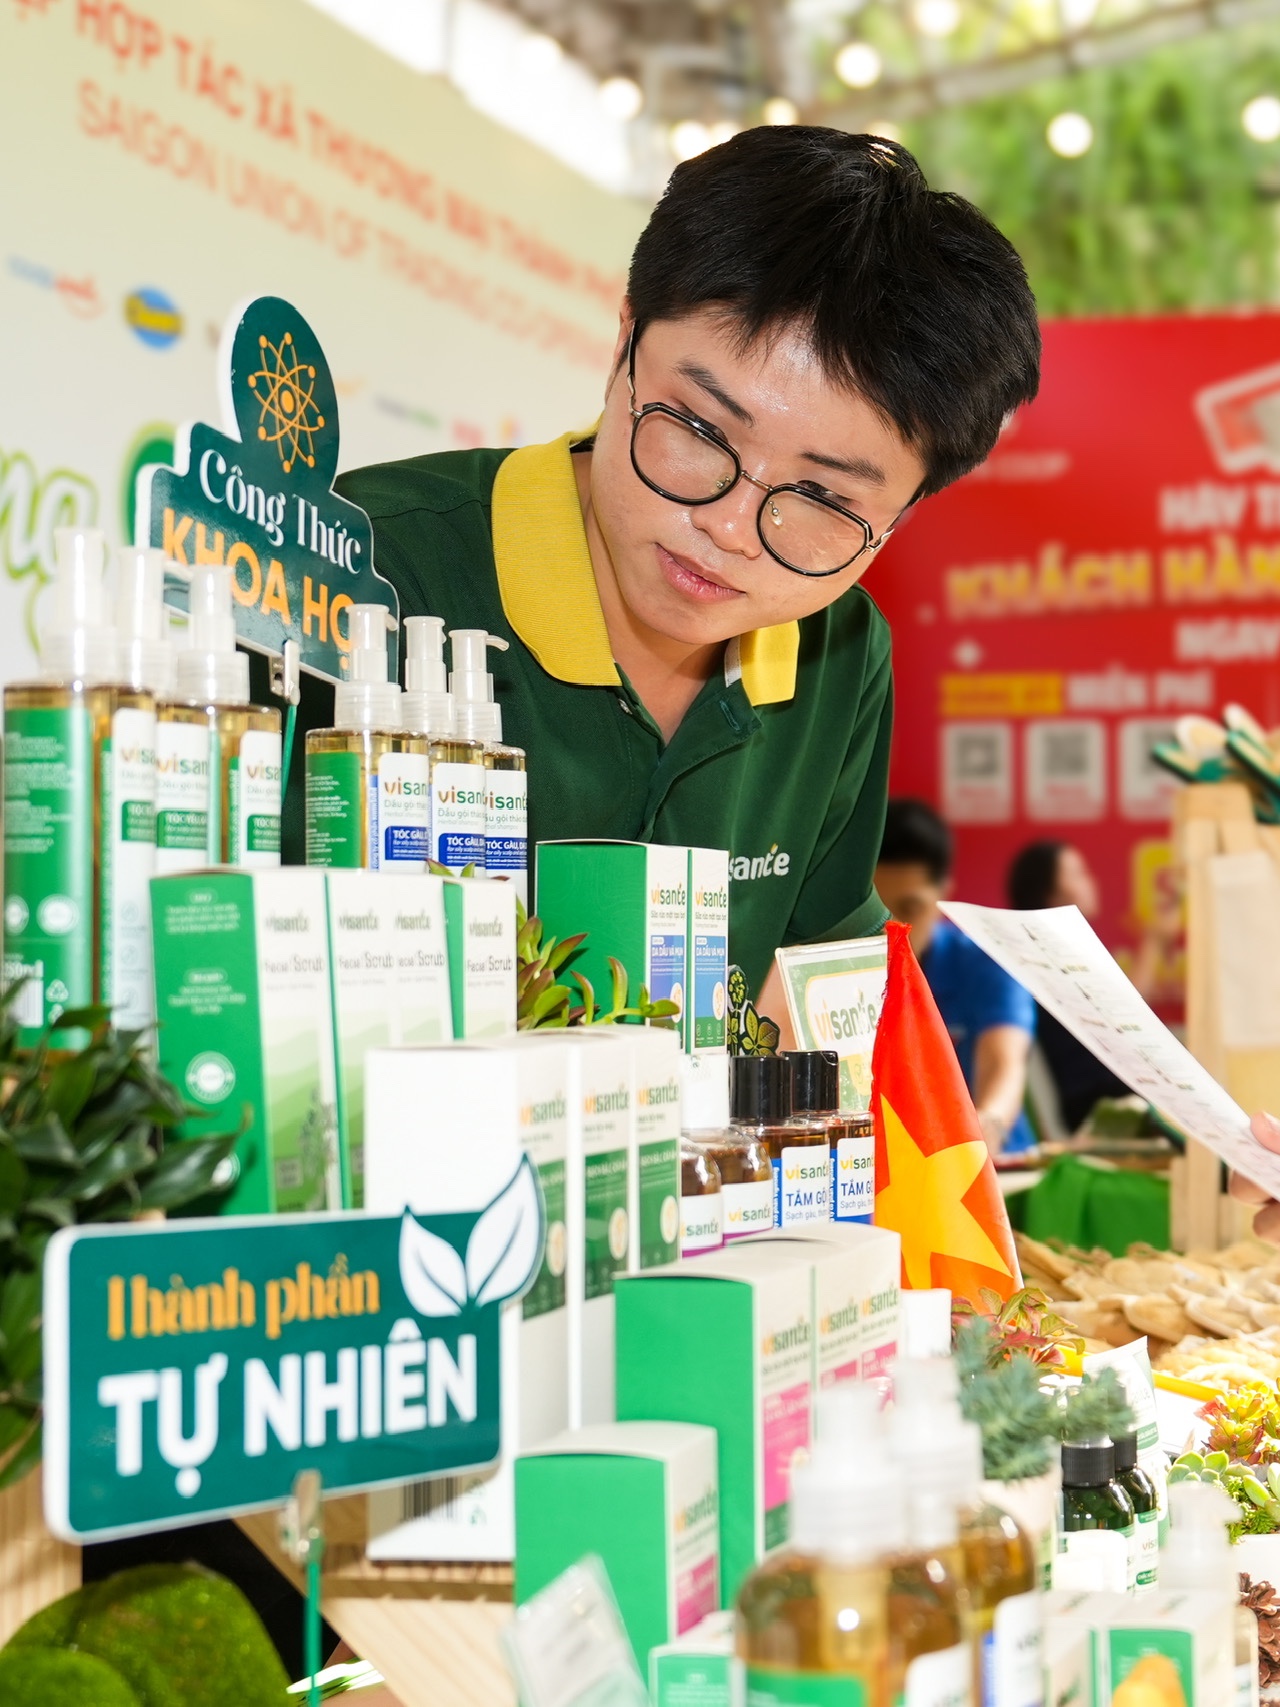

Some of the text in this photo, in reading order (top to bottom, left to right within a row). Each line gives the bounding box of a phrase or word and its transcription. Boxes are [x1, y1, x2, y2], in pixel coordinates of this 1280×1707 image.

[78, 78, 216, 192] SAIGON
[199, 448, 362, 575] Công Thức
[163, 508, 355, 670] KHOA HỌ
[384, 777, 427, 796] visan
[786, 1186, 828, 1207] TẮM GỘ
[107, 1253, 380, 1341] Thành phần
[98, 1317, 478, 1498] TỰ NHIÊN
